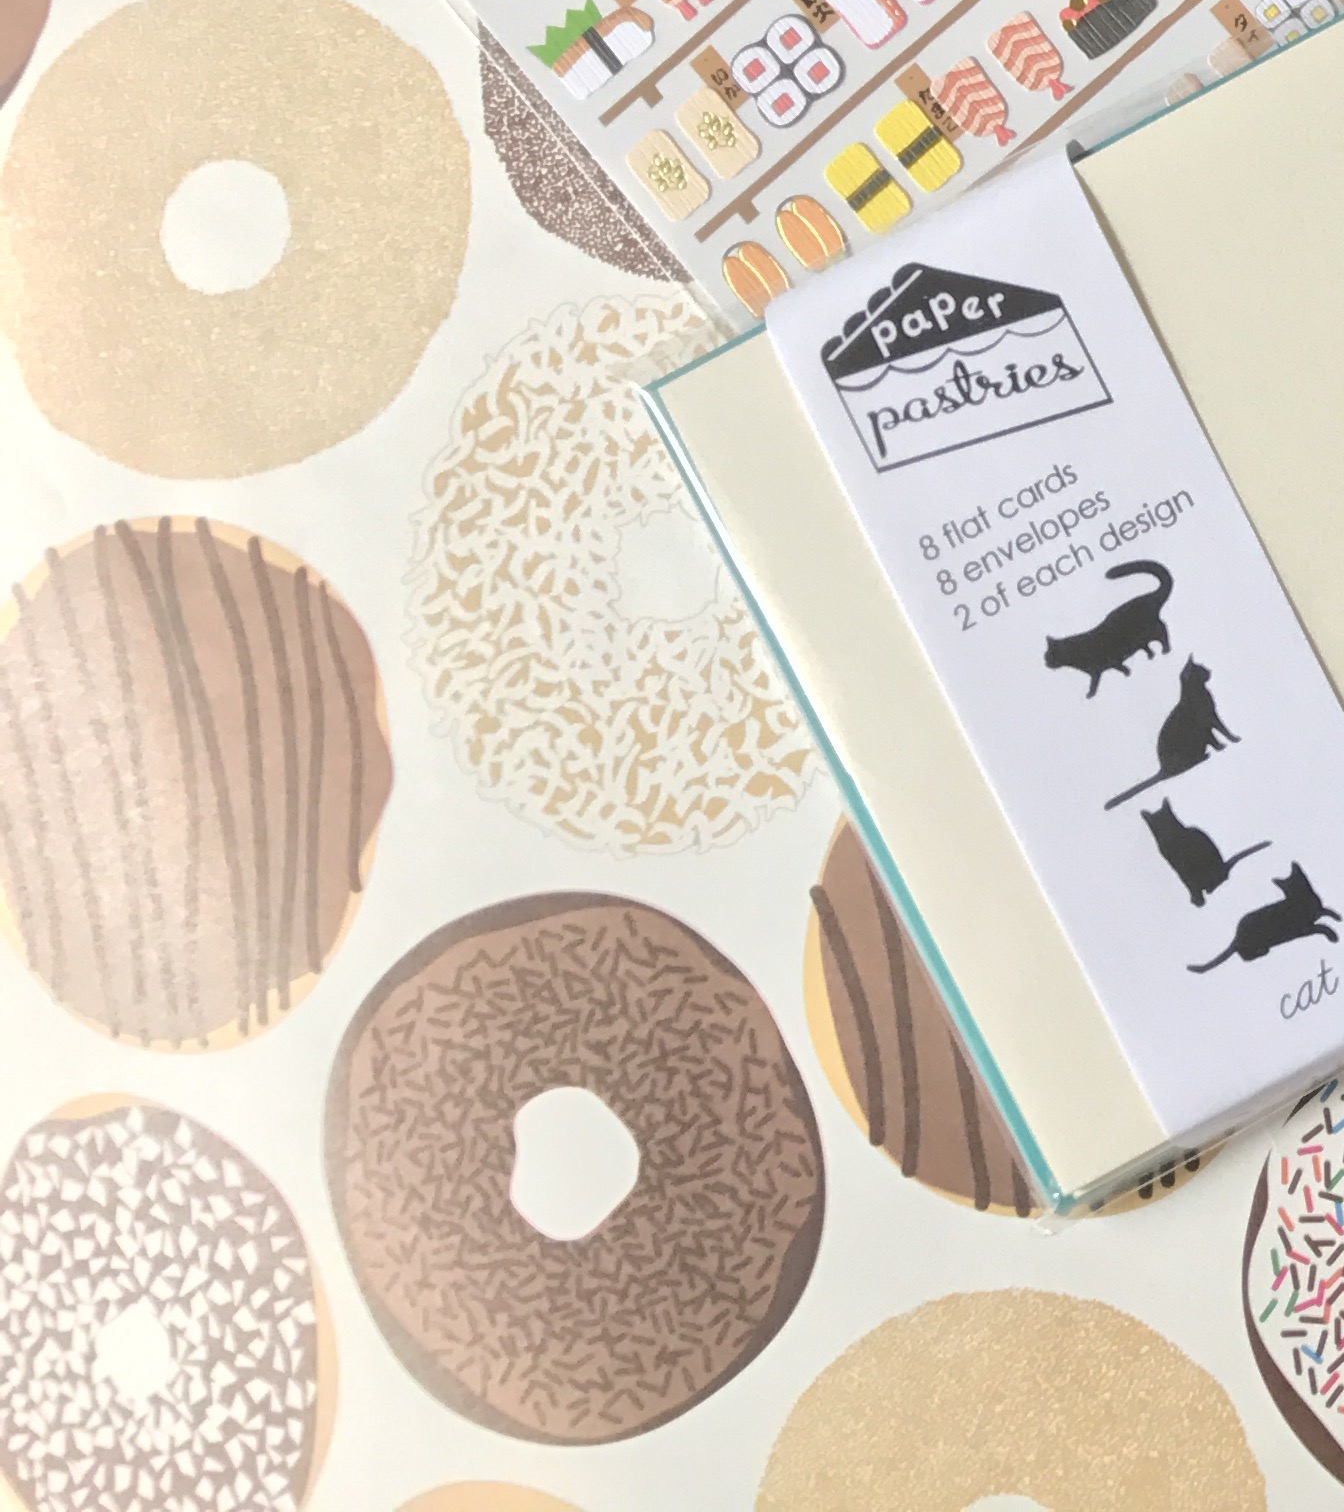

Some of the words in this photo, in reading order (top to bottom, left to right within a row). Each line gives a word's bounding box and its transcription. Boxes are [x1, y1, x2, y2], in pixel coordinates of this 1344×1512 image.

[867, 353, 1085, 459] pastries
[920, 533, 939, 563] 8
[943, 505, 992, 550] flat
[999, 461, 1079, 521] cards
[937, 568, 957, 597] 8
[962, 489, 1111, 584] envelopes
[953, 603, 976, 632] 2
[980, 582, 1010, 619] of
[1016, 543, 1095, 599] each
[1099, 489, 1196, 553] design
[1280, 958, 1339, 1020] cat
